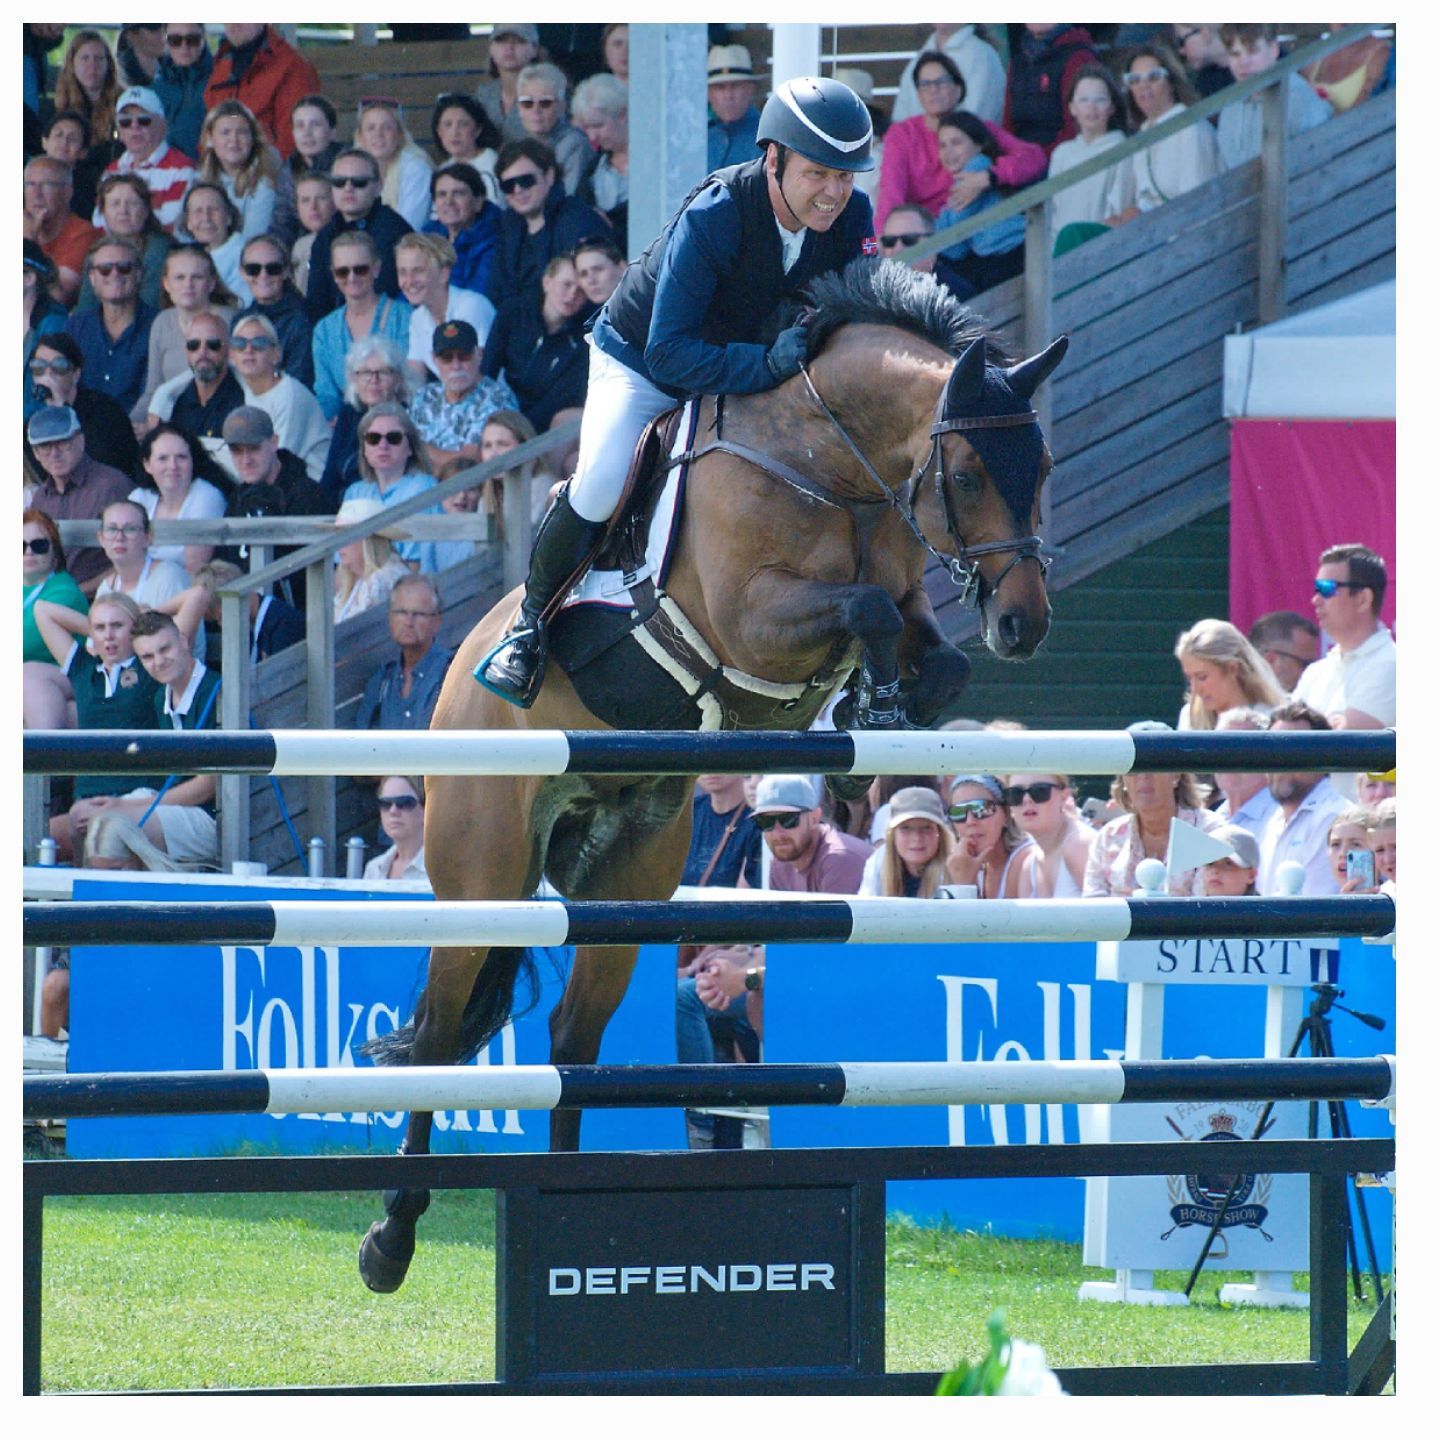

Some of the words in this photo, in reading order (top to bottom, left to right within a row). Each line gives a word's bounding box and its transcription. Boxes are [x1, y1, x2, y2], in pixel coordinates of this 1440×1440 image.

[1157, 939, 1301, 975] START
[221, 947, 525, 1135] Folks
[1224, 1208, 1258, 1224] SHOW
[549, 1263, 835, 1296] DEFENDER
